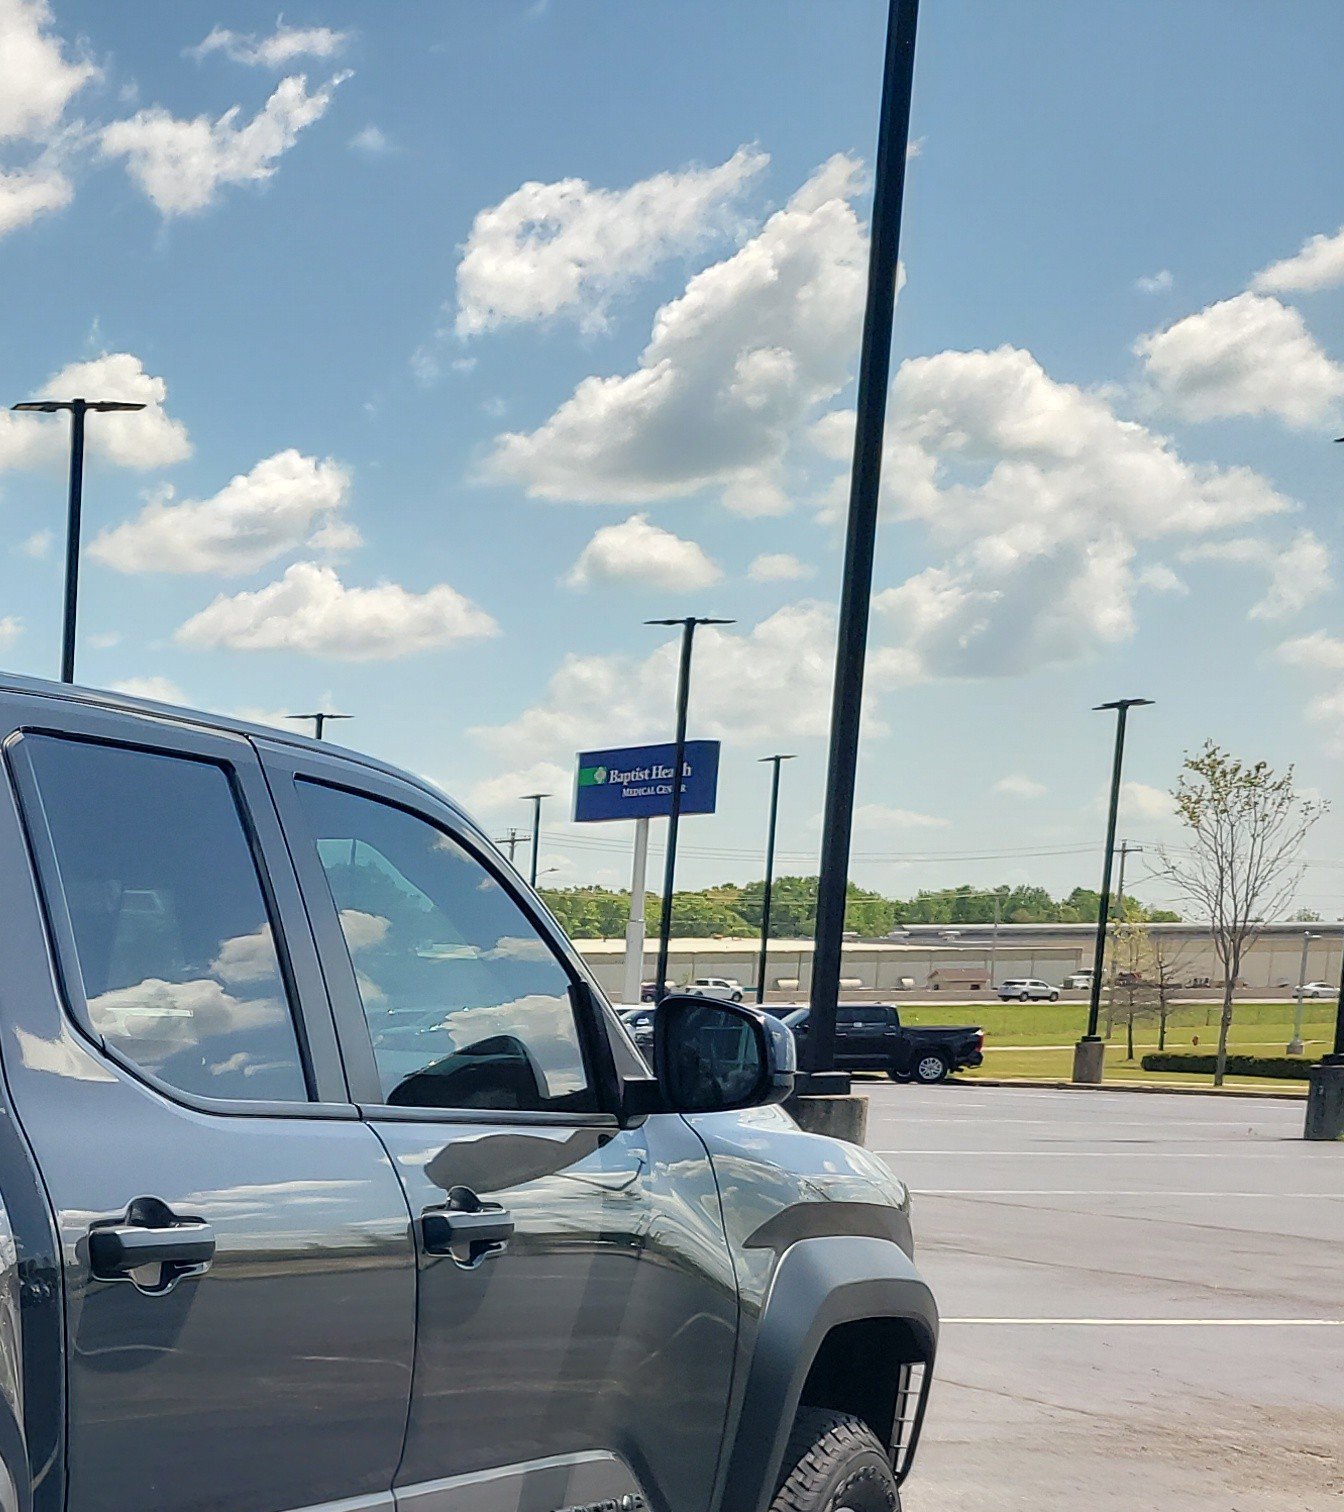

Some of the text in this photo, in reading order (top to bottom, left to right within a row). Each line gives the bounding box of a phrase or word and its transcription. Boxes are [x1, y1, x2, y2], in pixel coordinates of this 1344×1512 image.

[609, 762, 692, 785] Baptist Heah
[622, 784, 686, 797] MEDICAL CENR
